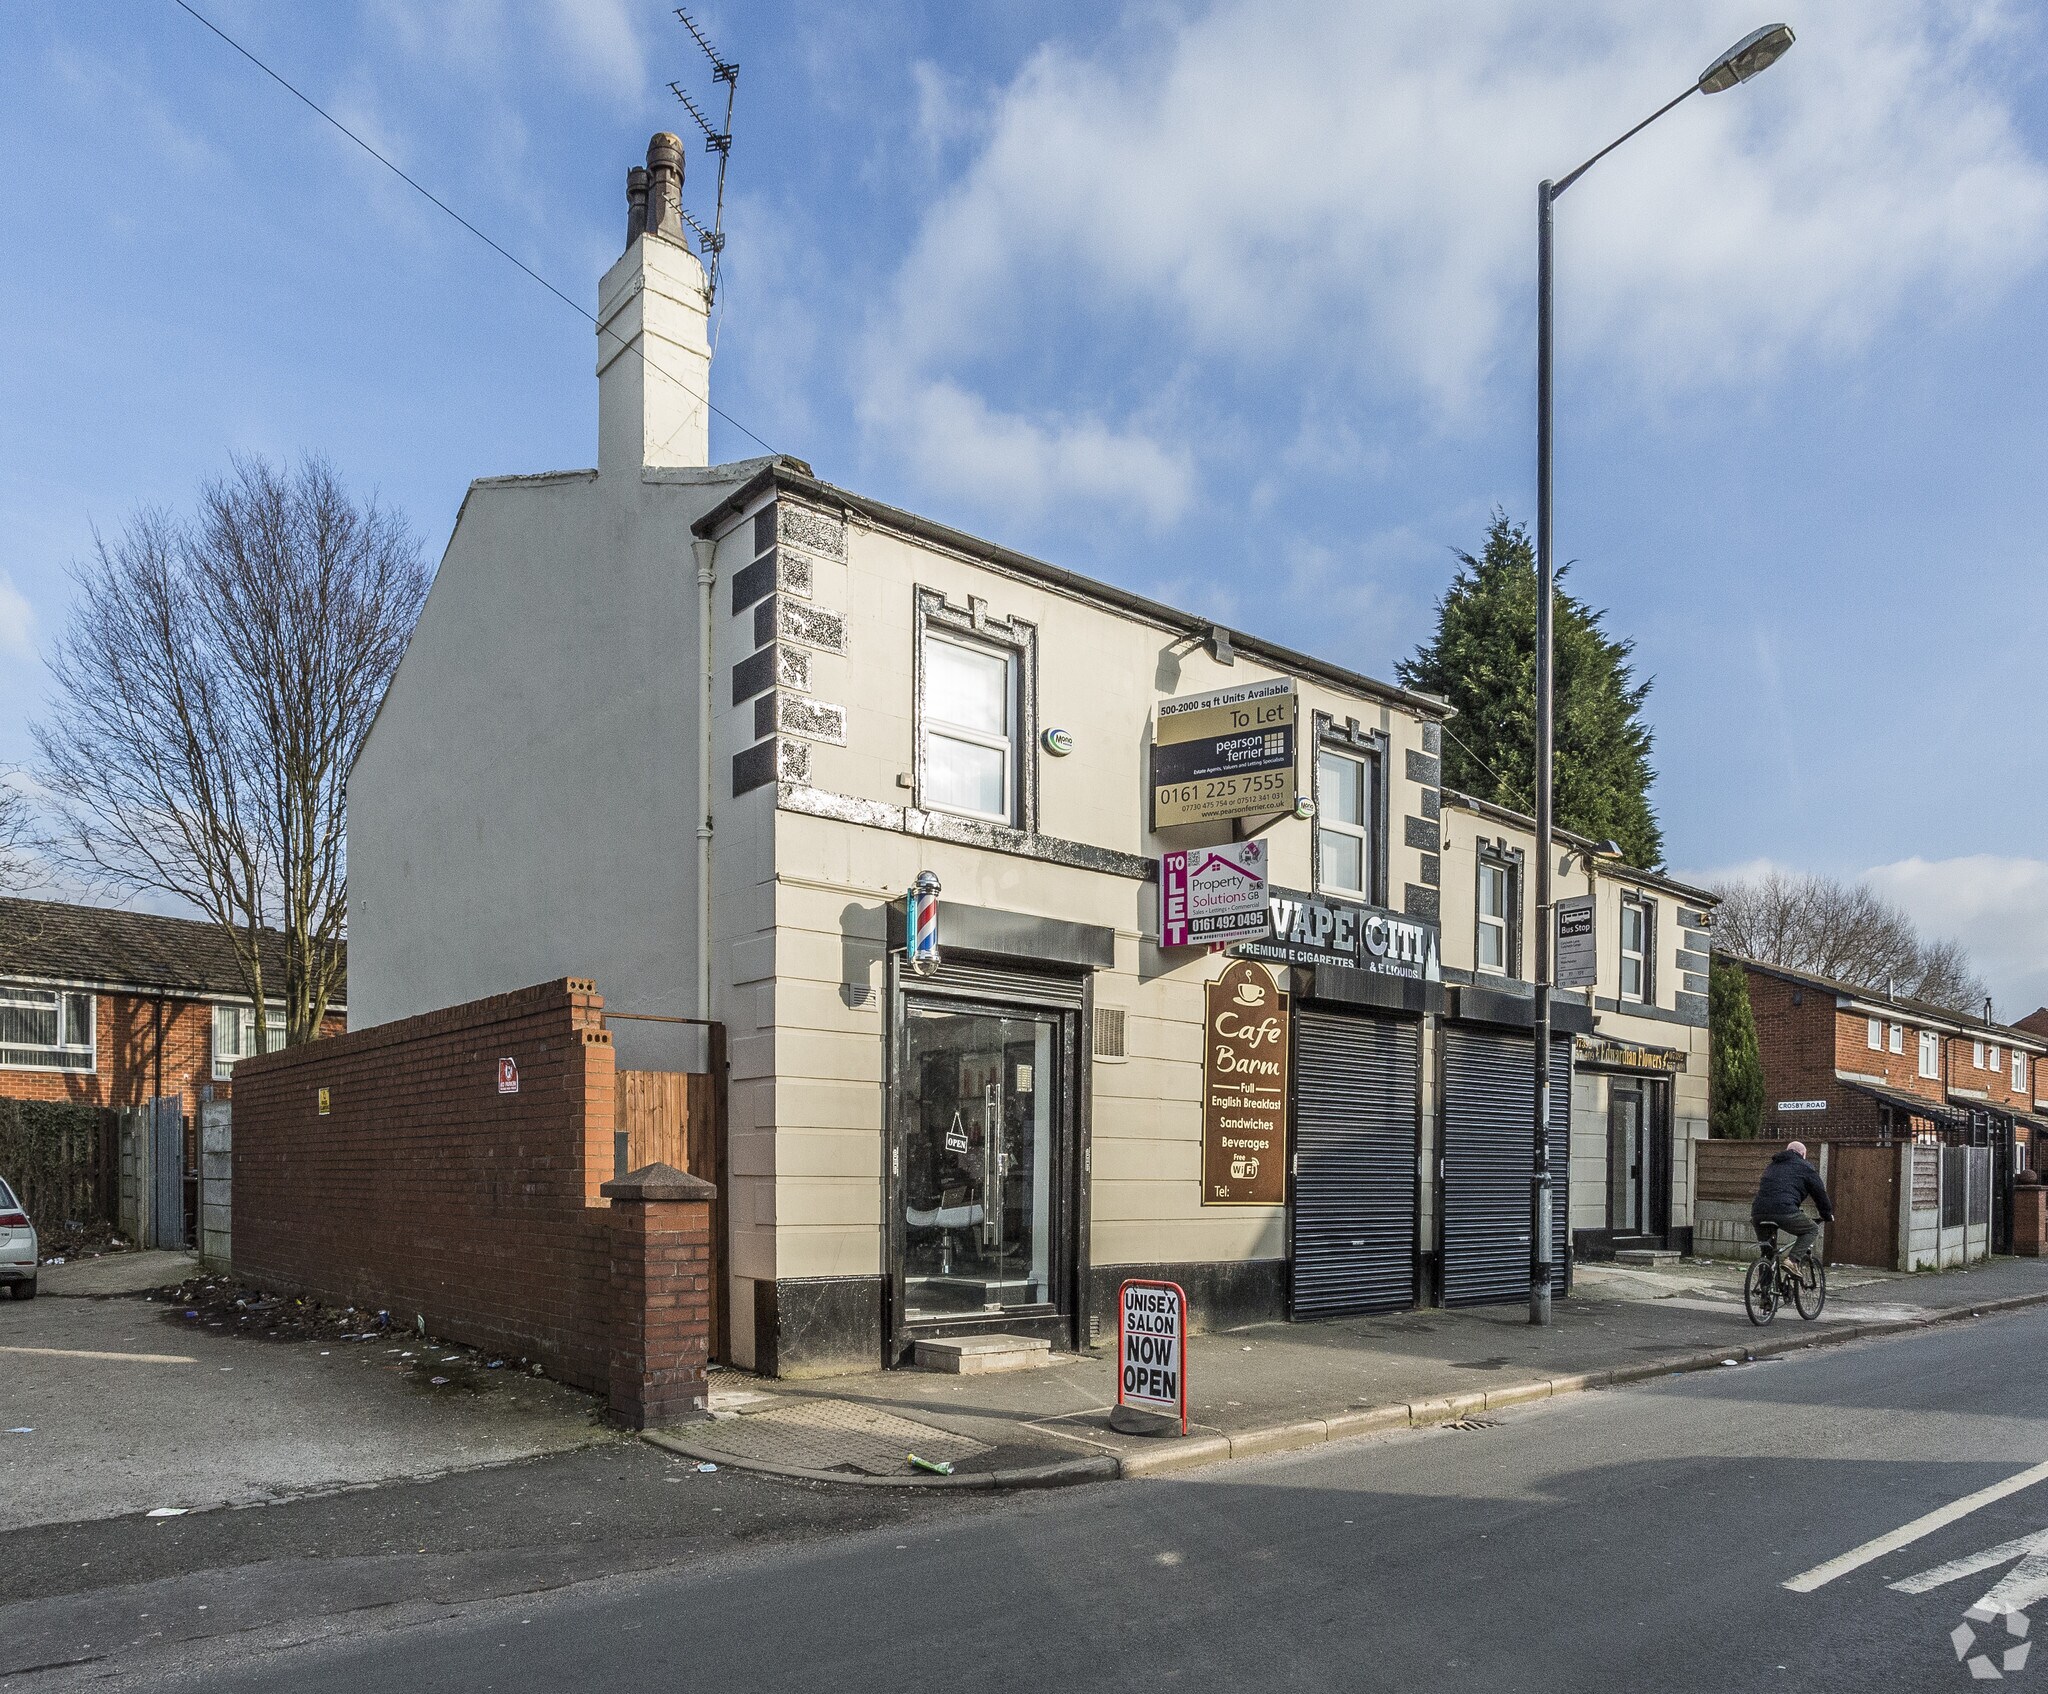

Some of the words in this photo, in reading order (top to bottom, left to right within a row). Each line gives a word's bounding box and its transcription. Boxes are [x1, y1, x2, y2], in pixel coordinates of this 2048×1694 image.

[1161, 701, 1199, 716] 500-2000
[1214, 697, 1220, 706] ft
[1222, 694, 1245, 704] Units
[1248, 685, 1288, 699] Available
[1230, 710, 1249, 728] To
[1257, 704, 1284, 724] Let
[1216, 736, 1262, 754] pearson
[1228, 746, 1262, 762] ferrier
[1248, 760, 1262, 768] Letting
[1161, 785, 1198, 804] 0161
[1206, 780, 1236, 798] 225
[1242, 773, 1284, 794] 7555
[1182, 804, 1201, 812] 07730
[1202, 801, 1214, 809] 475
[1236, 796, 1256, 804] 07512
[1258, 794, 1270, 802] 341
[1272, 792, 1284, 800] 031
[1202, 802, 1284, 818] www.pearsonferrier.co.uk
[1168, 856, 1185, 871] TO
[1192, 876, 1244, 892] Property
[1168, 873, 1185, 944] LET
[1193, 892, 1246, 908] Solutions
[1248, 892, 1259, 900] GB
[1208, 906, 1227, 914] Lettings
[1231, 902, 1260, 910] Commercial
[1192, 918, 1214, 932] 0161
[1216, 915, 1236, 928] 492
[1238, 912, 1263, 926] 0495
[1270, 898, 1354, 952] VAPE
[1365, 916, 1424, 964] CITI
[1562, 926, 1574, 934] Bus
[1575, 924, 1590, 932] Stop
[1239, 943, 1286, 958] PREMIUM
[1289, 950, 1295, 960] E
[1298, 951, 1354, 968] CIGARETTES
[1370, 962, 1378, 972] &
[1378, 964, 1384, 974] E
[1386, 965, 1418, 978] LIQUIDS
[1216, 1012, 1281, 1048] Cafe
[1216, 1045, 1280, 1076] Barm
[1601, 1043, 1636, 1066] Edwardian
[1638, 1047, 1662, 1069] Flowers
[1241, 1082, 1254, 1094] Full
[1212, 1096, 1241, 1108] English
[1244, 1098, 1281, 1110] Breakfast
[1220, 1117, 1274, 1130] Sandwiches
[948, 1138, 965, 1149] OPEN
[1222, 1136, 1269, 1151] Beverages
[1215, 1186, 1230, 1197] Tel:
[1126, 1293, 1176, 1314] UNISEX
[1128, 1313, 1174, 1334] SALON
[1128, 1335, 1172, 1366] NOW
[1124, 1366, 1176, 1399] OPEN
